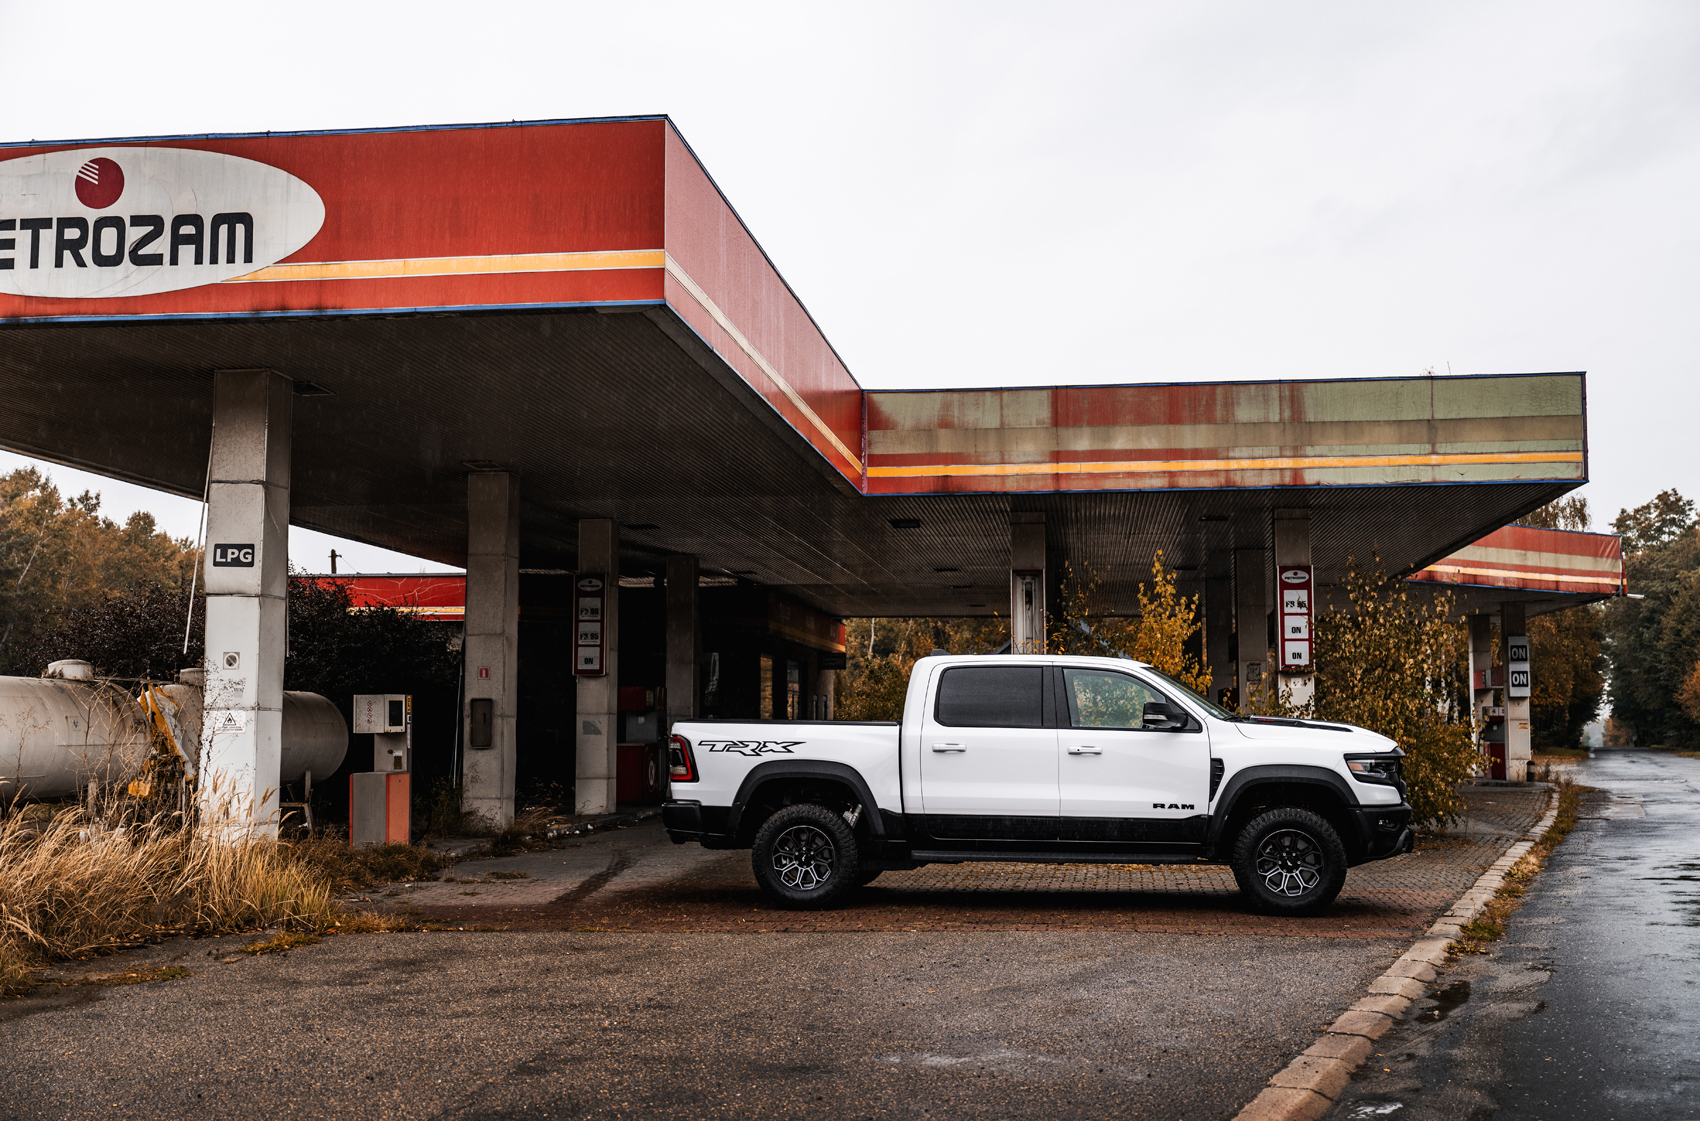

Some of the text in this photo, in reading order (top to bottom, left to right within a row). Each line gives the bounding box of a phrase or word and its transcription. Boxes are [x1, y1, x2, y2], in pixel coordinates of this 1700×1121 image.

[215, 548, 253, 563] LPG
[590, 607, 599, 615] 98
[1291, 626, 1301, 634] ON
[590, 632, 599, 640] 95
[1292, 652, 1302, 660] ON
[1511, 647, 1526, 659] ON
[584, 657, 594, 665] ON
[1512, 673, 1527, 685] ON
[698, 740, 806, 756] TRX
